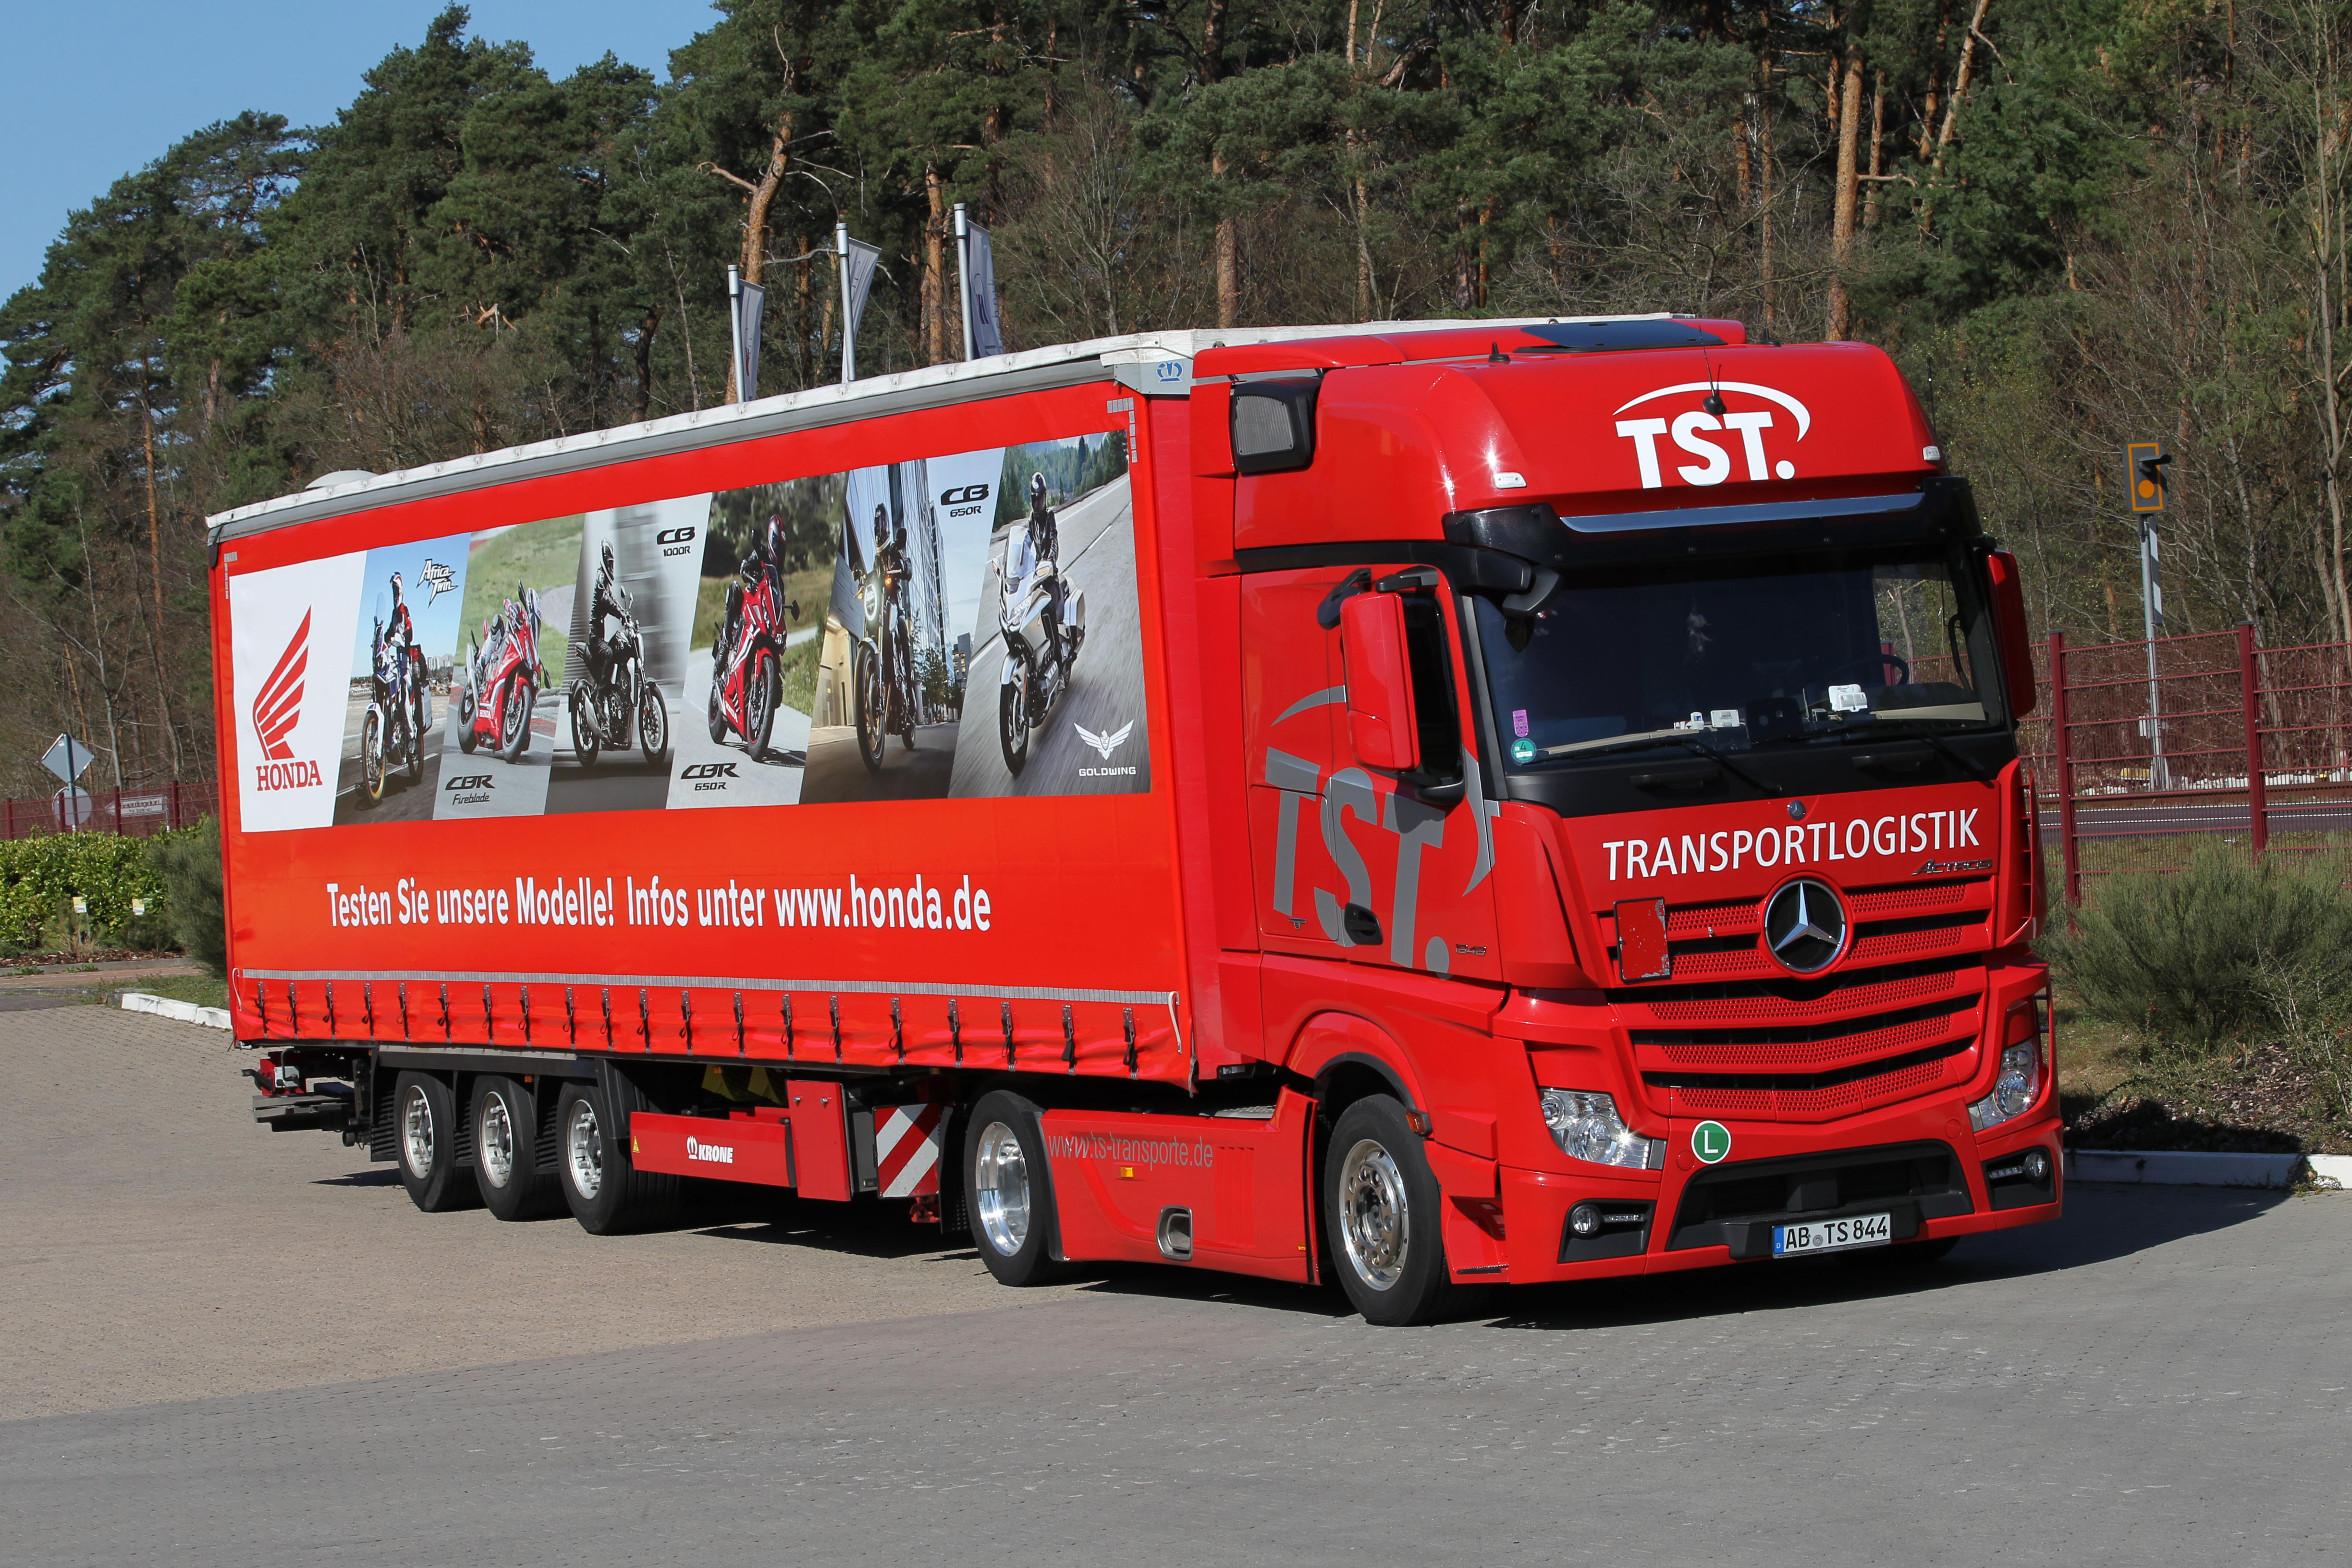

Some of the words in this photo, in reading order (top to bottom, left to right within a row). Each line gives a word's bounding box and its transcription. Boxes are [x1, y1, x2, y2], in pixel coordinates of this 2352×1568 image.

[1615, 411, 1796, 489] TST.
[941, 484, 989, 506] CB
[950, 505, 981, 517] 650R
[657, 526, 695, 545] CB
[663, 545, 691, 556] 1000R
[416, 558, 456, 589] Africa
[428, 578, 459, 609] Twin
[256, 760, 322, 791] HONDA
[680, 763, 740, 779] CBR
[1079, 767, 1136, 776] GOLDWING
[445, 775, 496, 790] CBR
[695, 782, 727, 791] 650R
[453, 792, 490, 805] Fireblade
[1603, 808, 1980, 881] TRANSPORTLOGISTIK
[327, 883, 392, 927] Testen
[397, 877, 429, 924] Sie
[436, 886, 509, 924] unsere
[515, 877, 615, 926] Modelle!
[626, 875, 689, 926] Infos
[697, 879, 766, 927] unter
[773, 873, 992, 931] www.honda.de
[1049, 1131, 1213, 1171] www.ts-transporte.de
[1704, 1130, 1718, 1153] L
[698, 1144, 733, 1164] KRONE
[1786, 1226, 1810, 1249] AB
[1824, 1222, 1848, 1244] TS
[1853, 1216, 1887, 1240] 844
